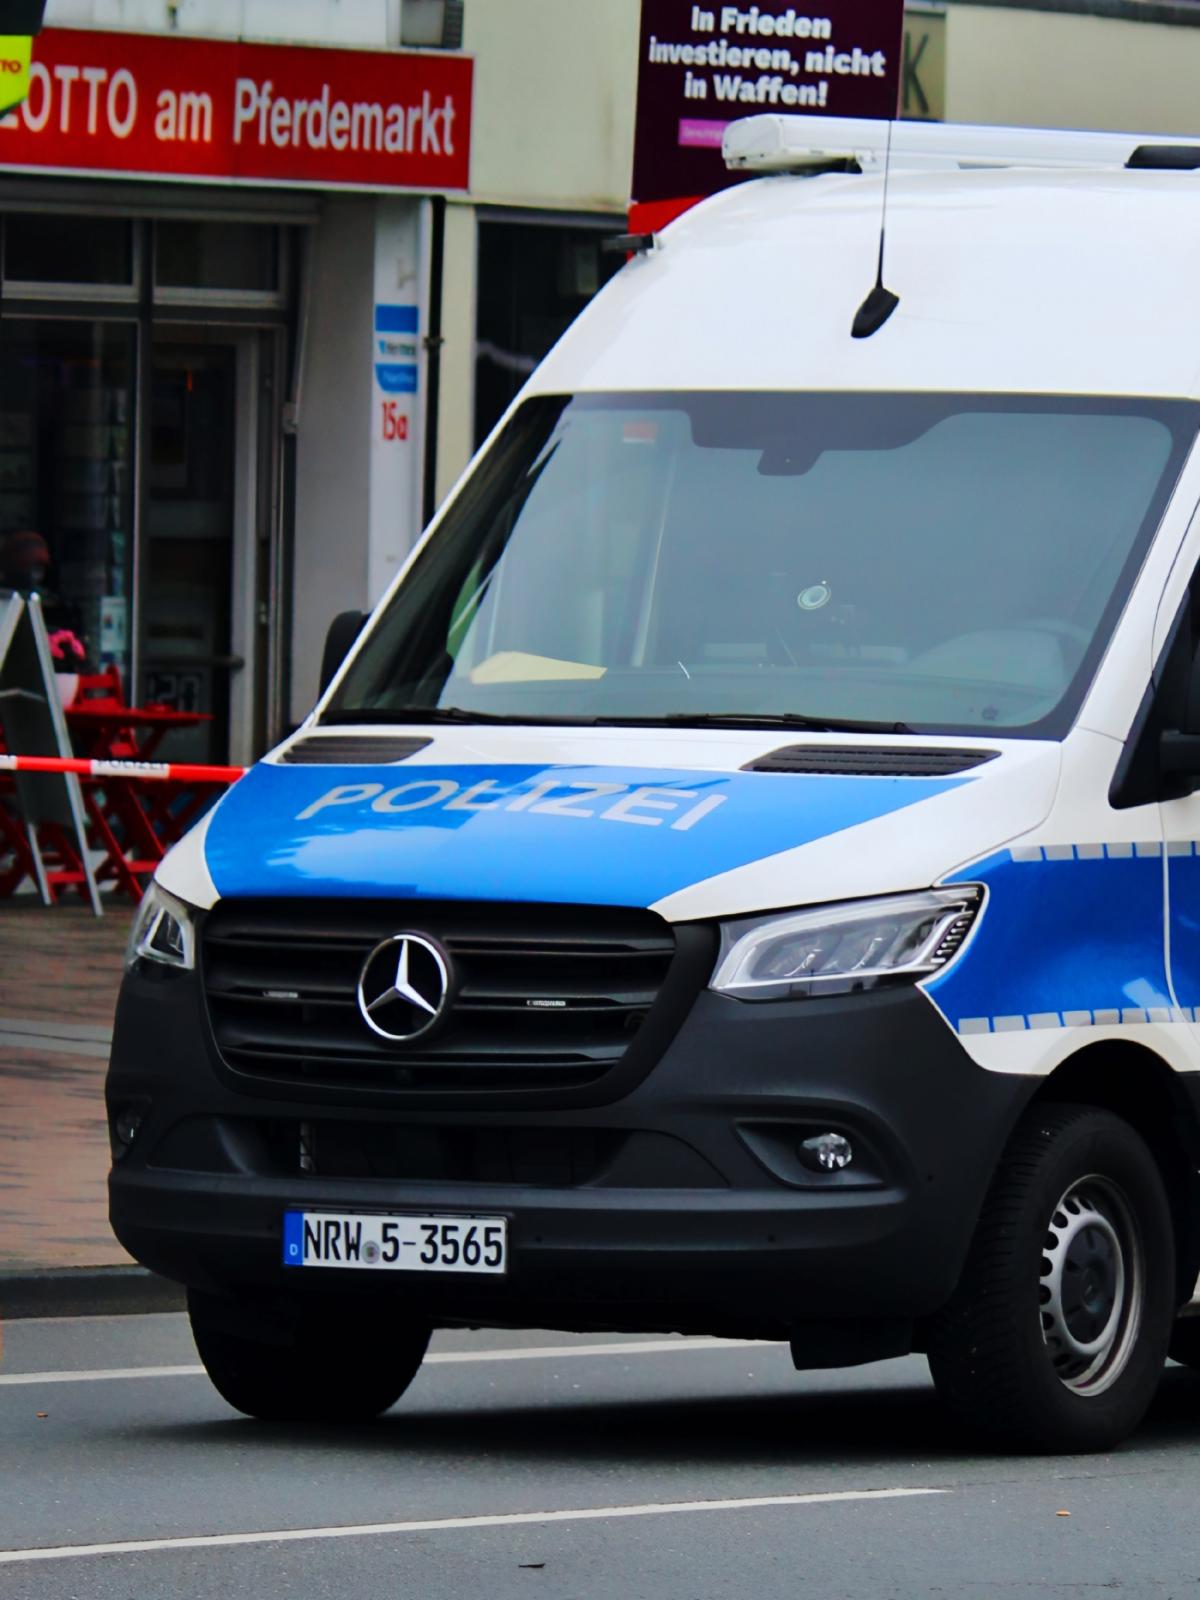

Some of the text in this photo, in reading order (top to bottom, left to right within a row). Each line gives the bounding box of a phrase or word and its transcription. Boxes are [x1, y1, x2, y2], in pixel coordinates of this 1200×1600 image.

[691, 5, 832, 39] In Frieden
[648, 35, 886, 77] investieren, nicht
[0, 61, 455, 156] OTTO am Pferdemarkt
[684, 71, 829, 107] in Waffen!
[382, 400, 408, 441] 15a
[294, 779, 728, 831] POLIZEI
[303, 1219, 502, 1267] NRW 5-3565
